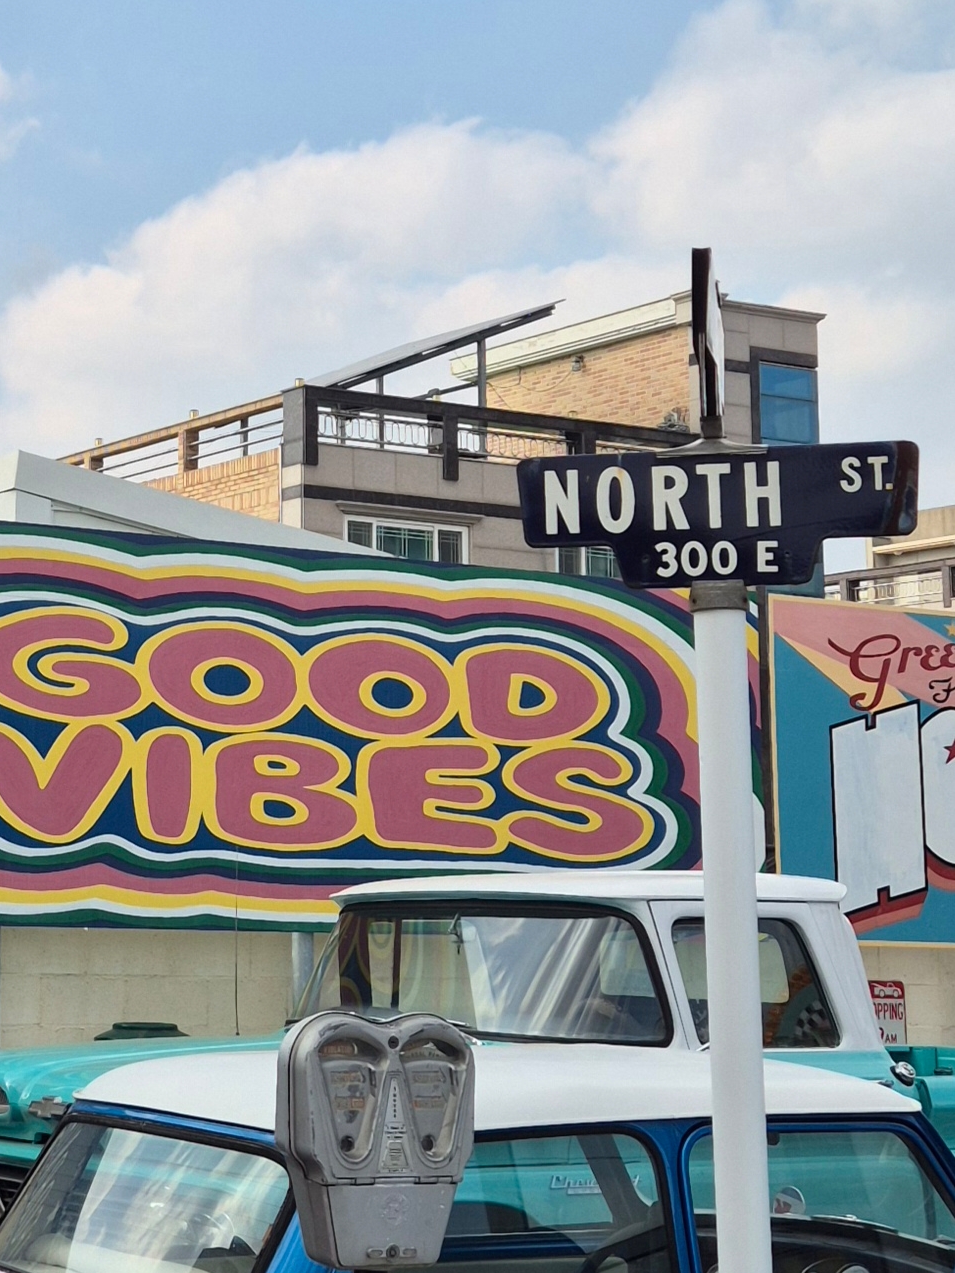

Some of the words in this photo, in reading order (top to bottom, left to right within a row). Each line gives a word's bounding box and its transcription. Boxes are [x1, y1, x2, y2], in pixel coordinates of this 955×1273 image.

[543, 460, 783, 535] NORTH
[839, 455, 894, 493] ST.
[654, 540, 738, 578] 300
[756, 540, 779, 573] E
